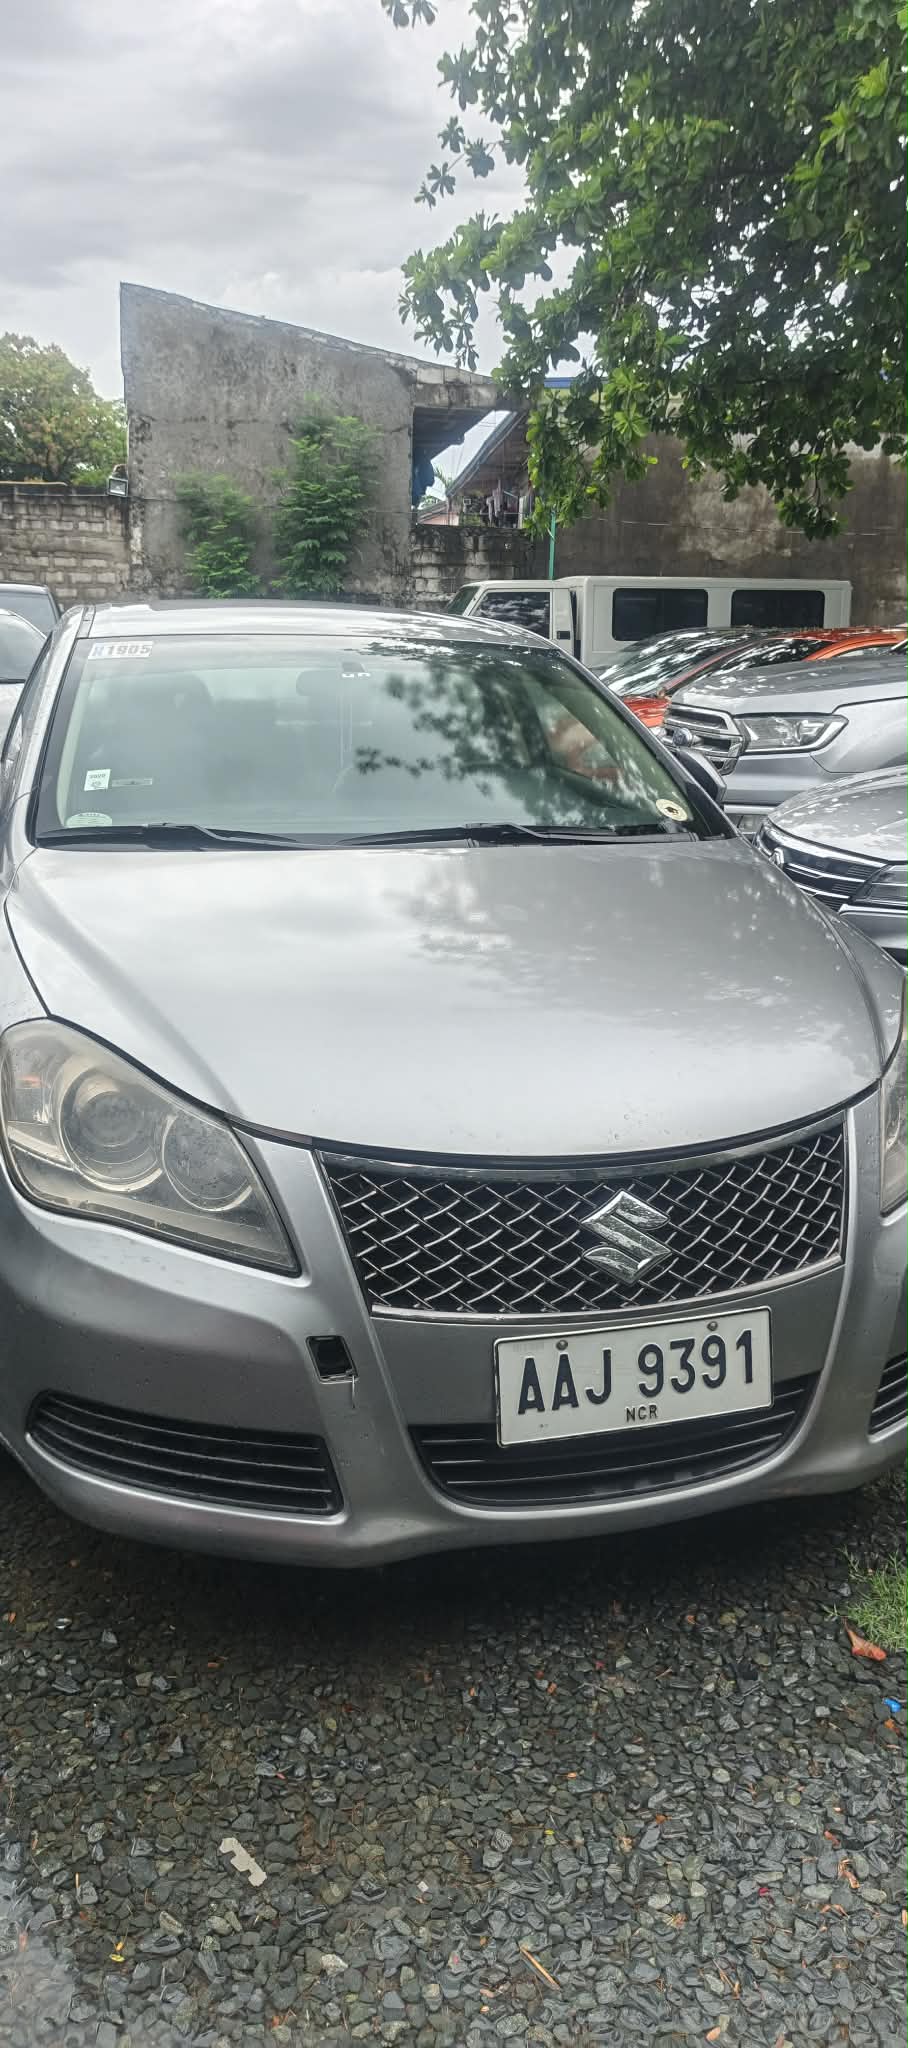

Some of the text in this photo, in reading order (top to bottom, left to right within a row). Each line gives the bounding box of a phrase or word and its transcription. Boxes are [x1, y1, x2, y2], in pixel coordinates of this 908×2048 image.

[518, 1329, 753, 1415] AAJ 9391
[626, 1404, 659, 1423] NCR
